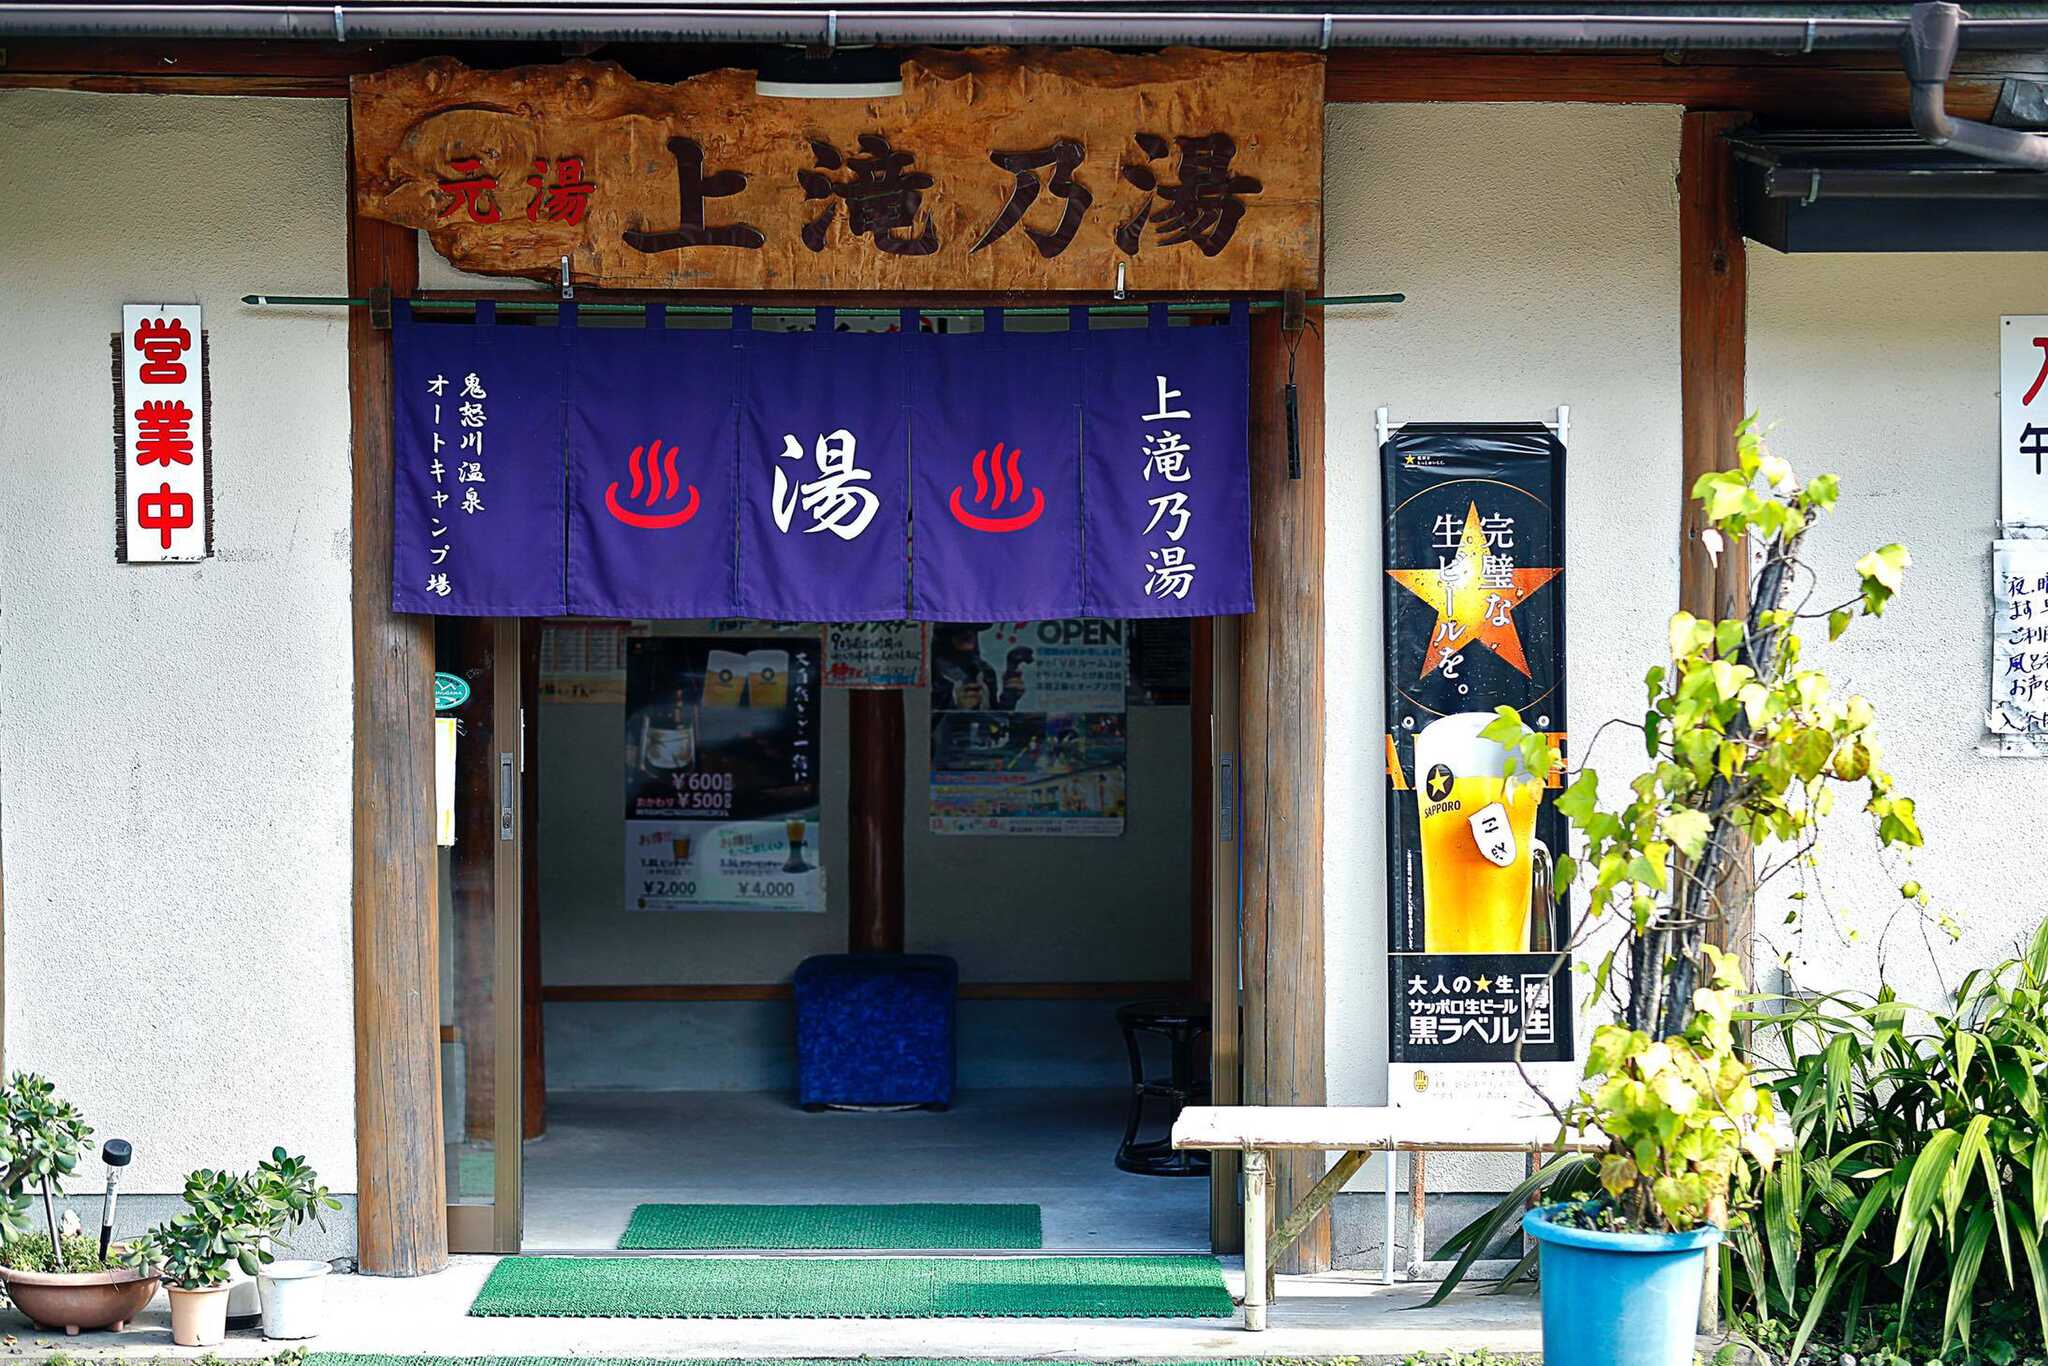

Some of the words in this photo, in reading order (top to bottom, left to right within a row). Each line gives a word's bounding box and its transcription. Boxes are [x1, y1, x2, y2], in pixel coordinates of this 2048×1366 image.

[438, 159, 597, 226] 元湯
[622, 131, 1263, 258] 上滝乃湯
[133, 318, 194, 550] 営業中
[426, 374, 452, 598] オートキャンプ場
[458, 372, 487, 514] 鬼怒川温泉
[772, 429, 880, 540] 湯
[1141, 375, 1196, 600] 上滝乃湯
[1431, 513, 1469, 695] 生ビールを。
[1480, 511, 1516, 627] 完璧な
[1037, 619, 1122, 645] OPEN
[1424, 800, 1461, 819] SAPPORO
[643, 881, 697, 896] ¥2,000
[738, 881, 795, 897] ¥4,000
[1408, 998, 1519, 1015] サッポロ生ビール
[1408, 1015, 1519, 1045] 黒ラベル
